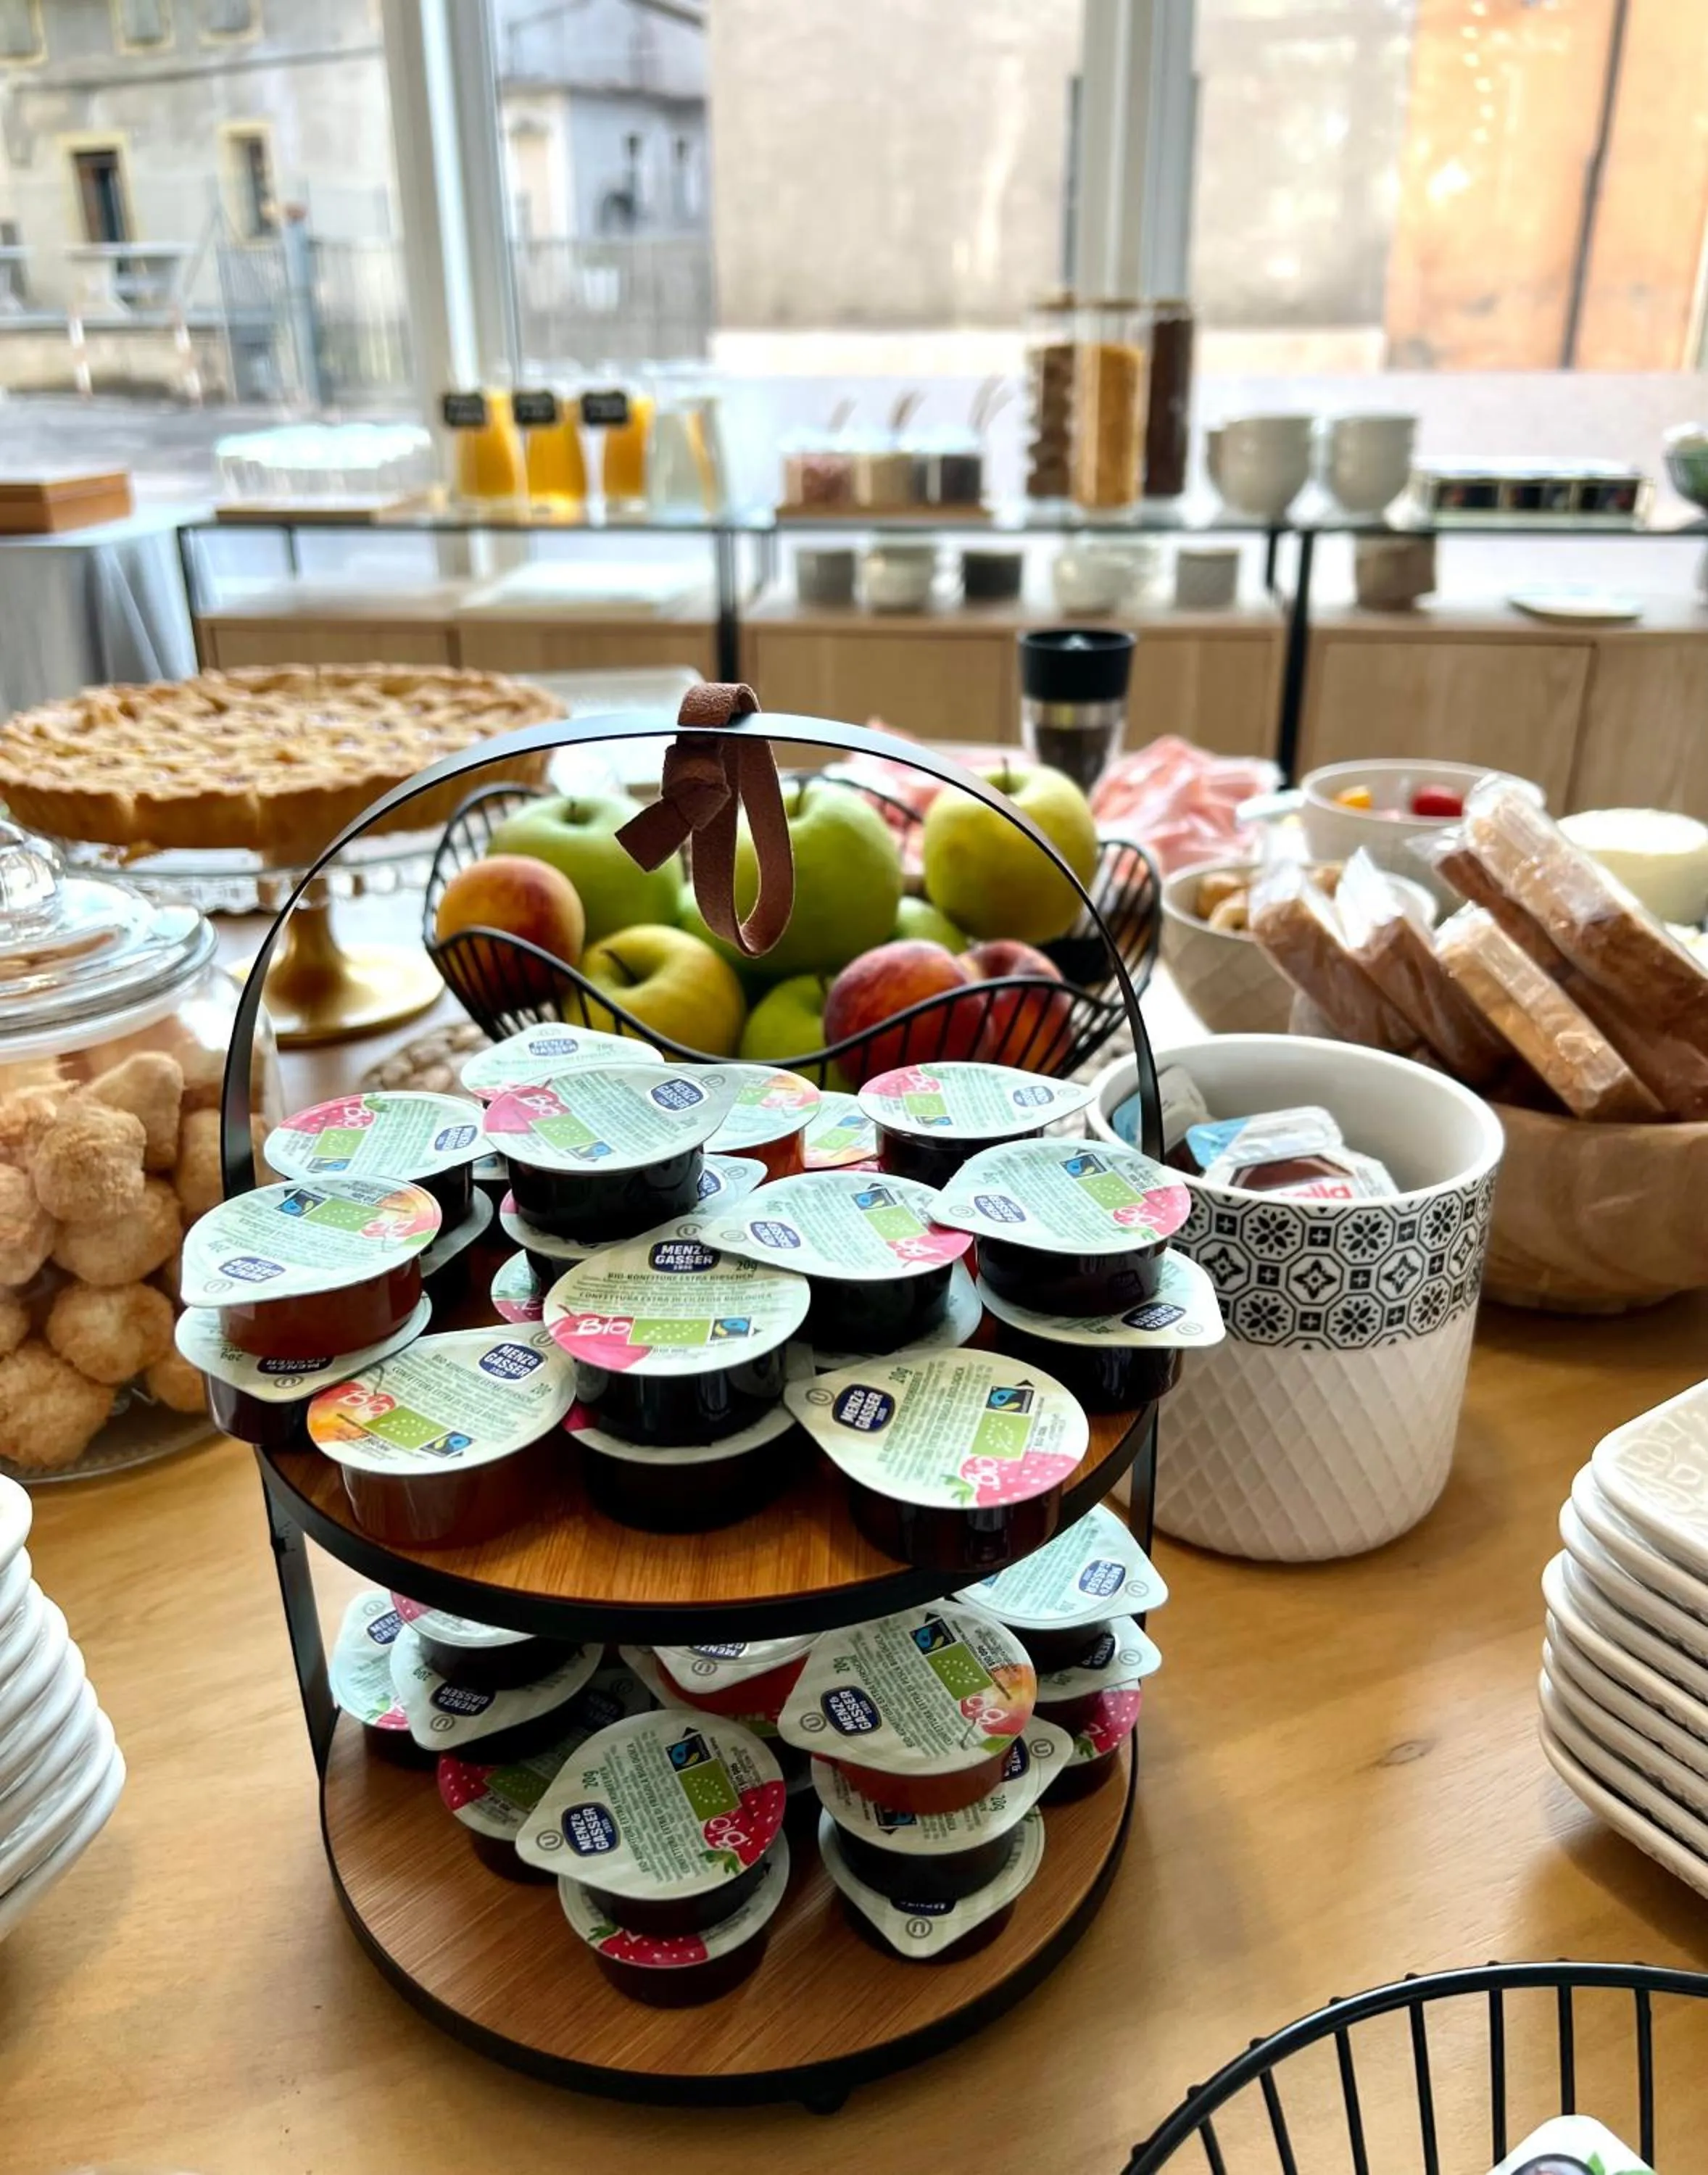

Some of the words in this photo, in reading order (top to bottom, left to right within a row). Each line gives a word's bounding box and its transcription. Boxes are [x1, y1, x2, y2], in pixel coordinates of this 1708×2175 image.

[654, 1255, 714, 1265] GASSER
[736, 1260, 758, 1272] 20g
[577, 1317, 631, 1337] Bio
[484, 1352, 531, 1377] GASSER
[855, 1392, 884, 1429] GASSER
[1085, 1562, 1112, 1594] GASSER
[441, 1687, 489, 1704] GASSER
[840, 1691, 872, 1730] GASSER
[582, 1770, 600, 1790] 20g
[990, 1794, 1007, 1812] 20g
[571, 1813, 594, 1851] MENZ&
[582, 1807, 610, 1850] GASSER
